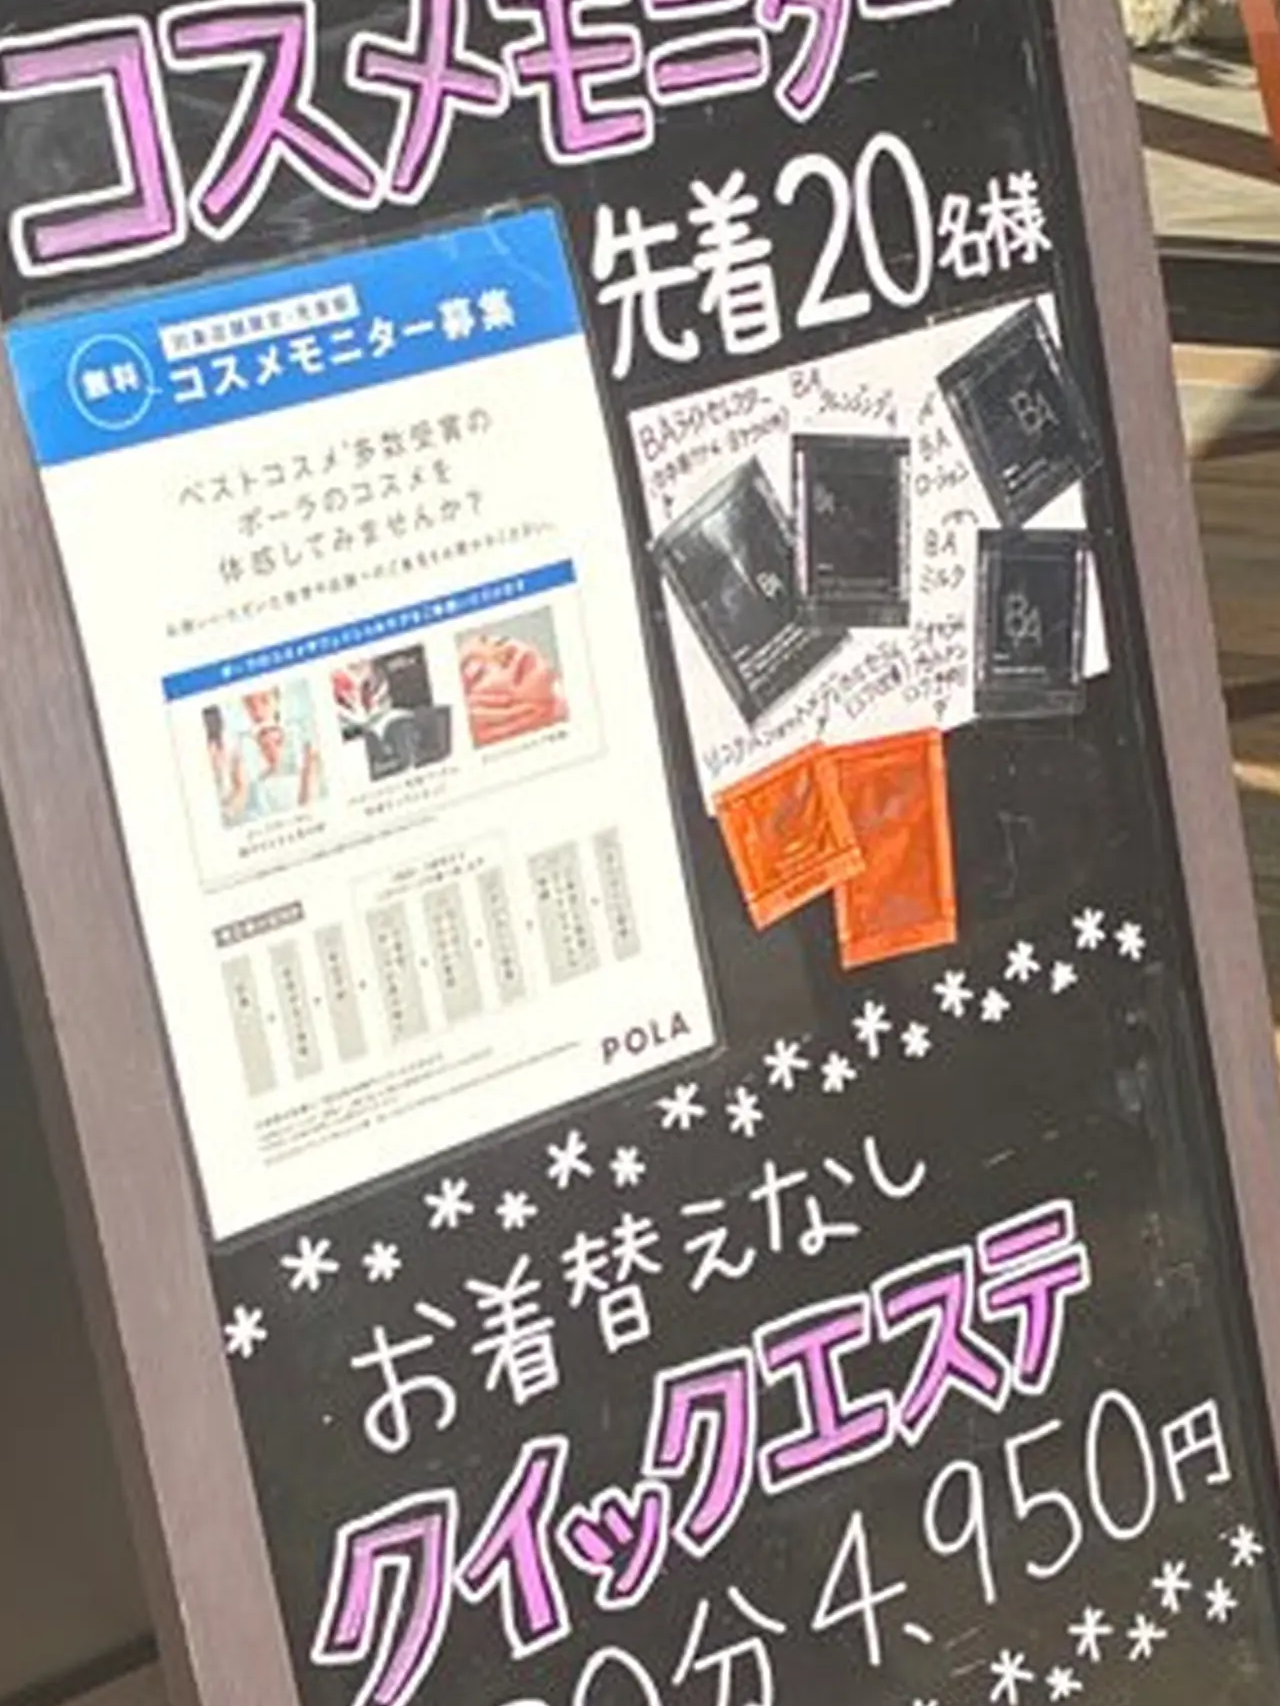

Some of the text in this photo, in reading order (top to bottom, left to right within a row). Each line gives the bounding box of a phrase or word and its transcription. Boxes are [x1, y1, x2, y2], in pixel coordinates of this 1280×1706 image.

[590, 132, 1053, 381] 先着20名様
[81, 361, 141, 398] 無料
[168, 287, 517, 405] コスメモニター募集
[235, 458, 454, 539] ポーラのコスメを
[600, 1010, 693, 1066] POLA
[350, 1135, 927, 1454] お着替えなし
